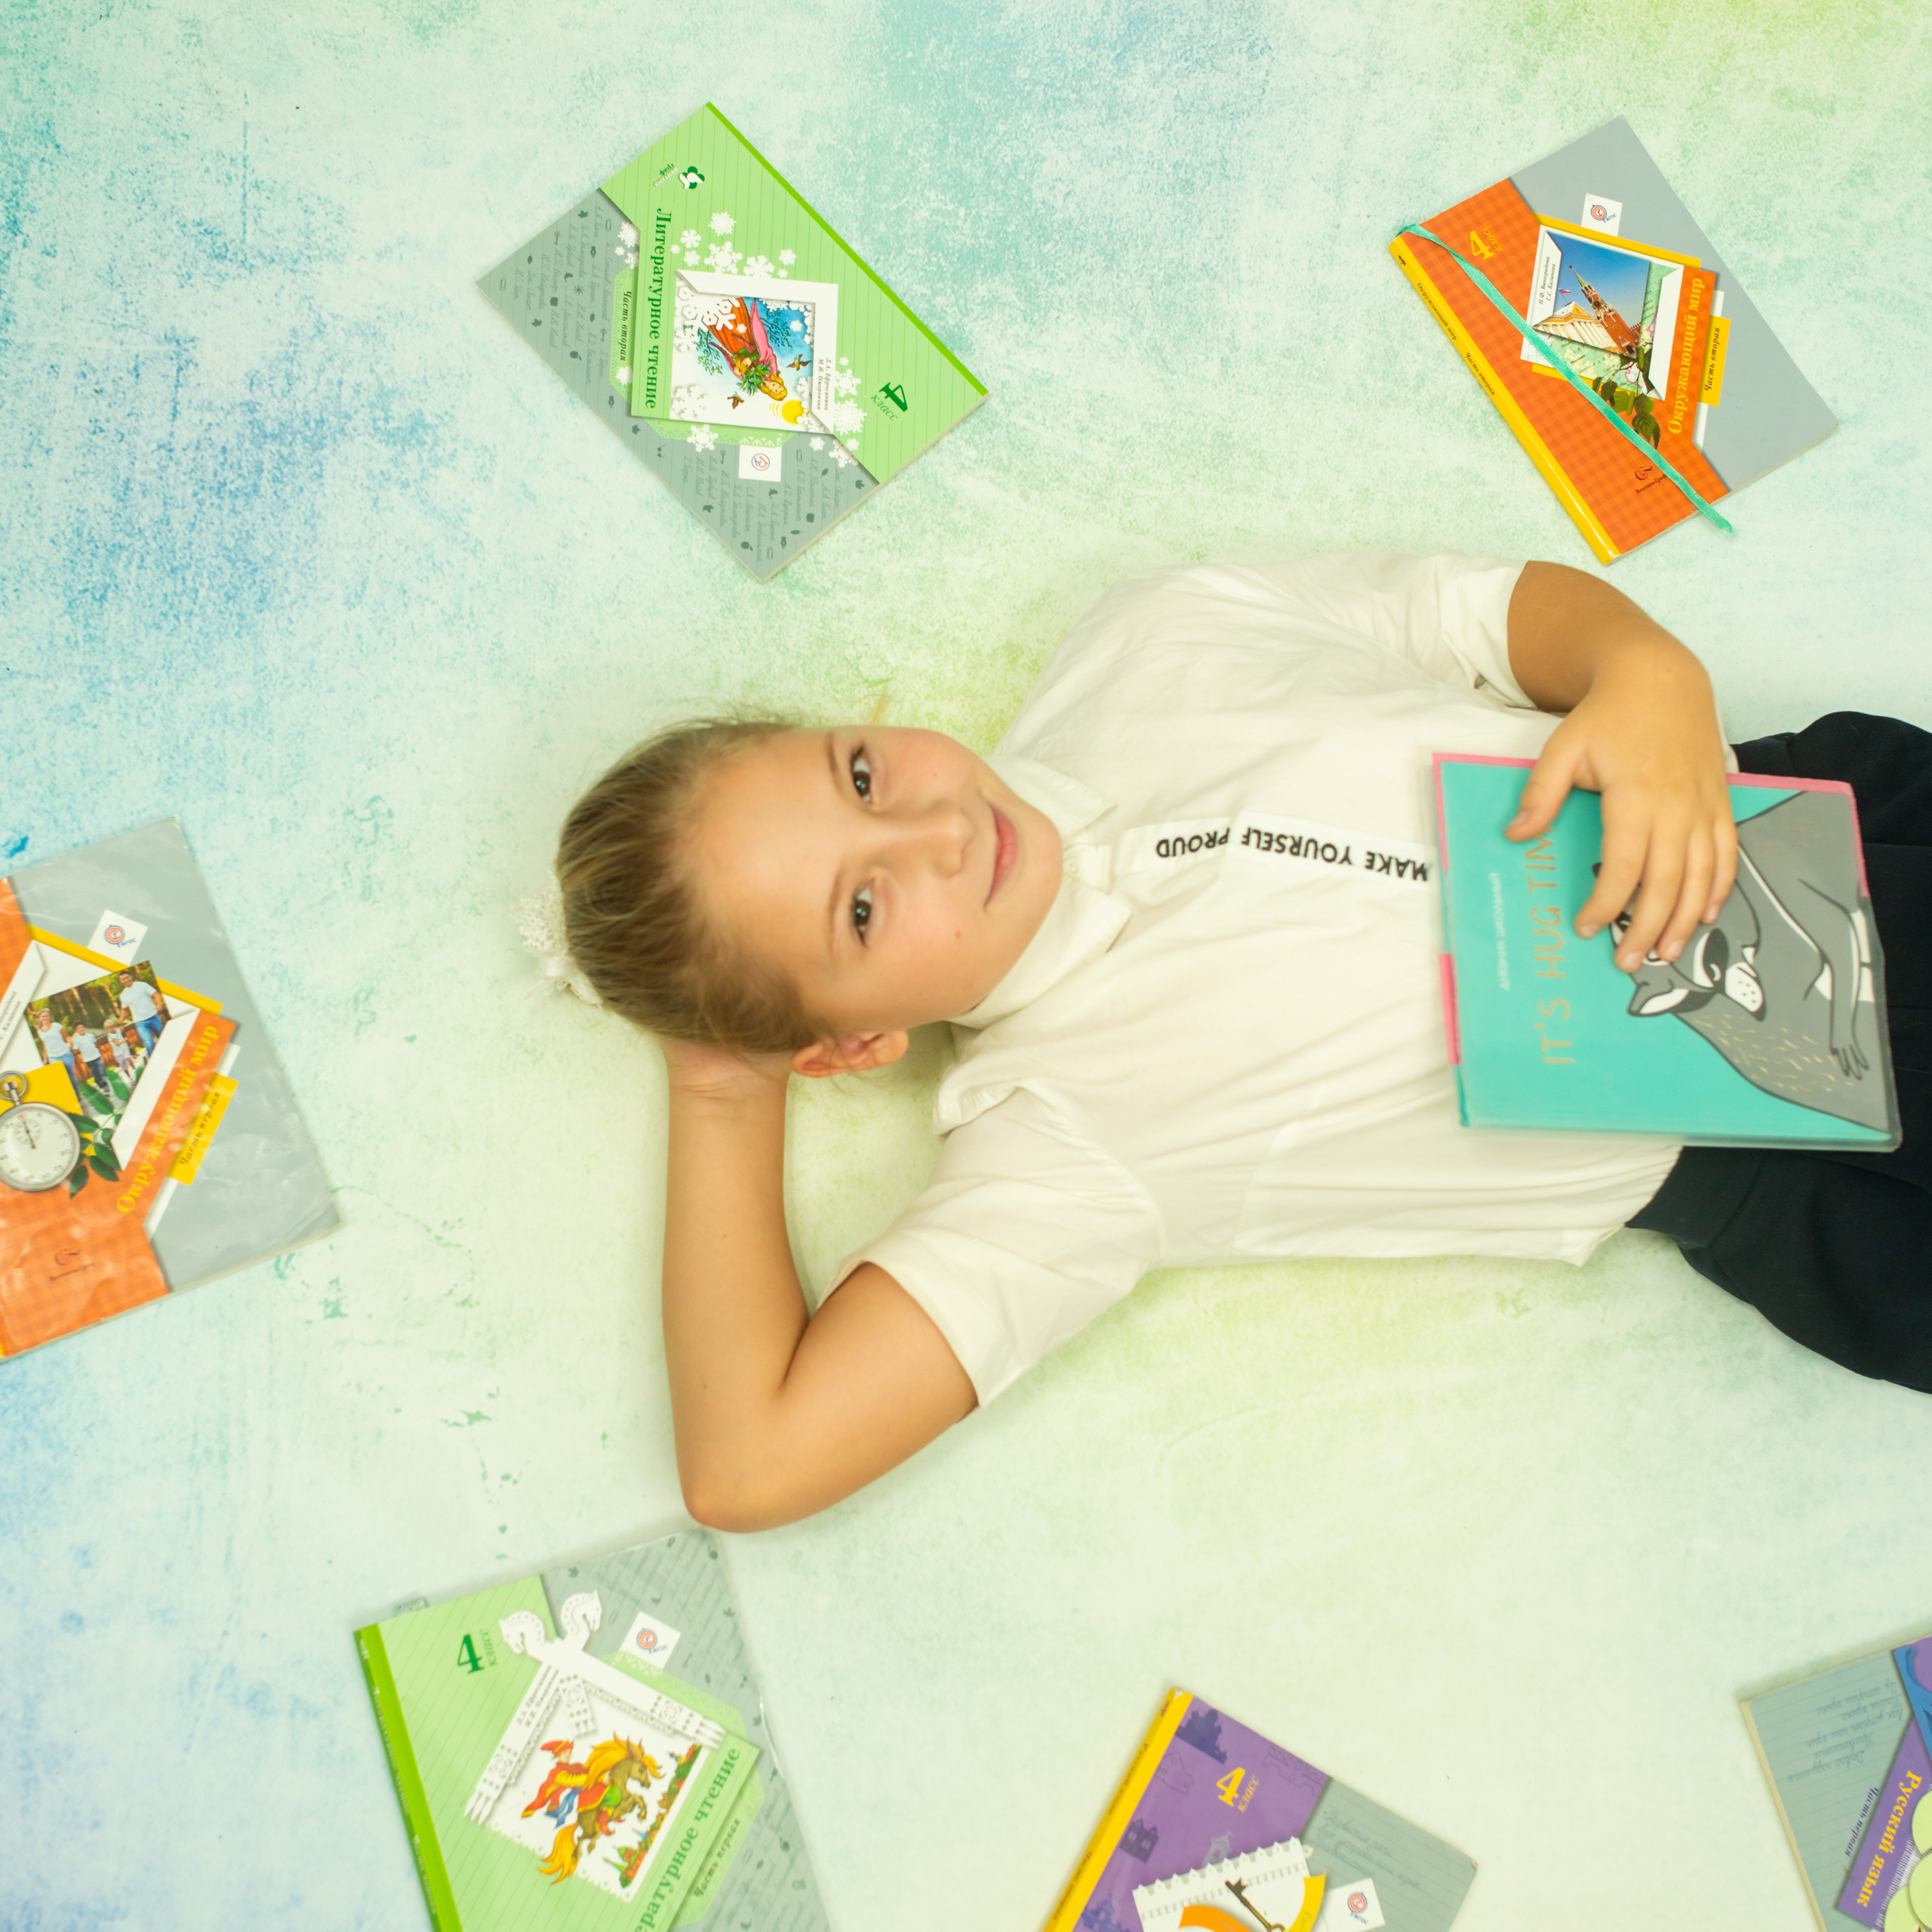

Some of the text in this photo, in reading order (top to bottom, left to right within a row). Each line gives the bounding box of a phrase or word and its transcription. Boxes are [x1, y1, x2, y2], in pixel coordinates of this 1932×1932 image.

[1395, 254, 1407, 266] 4
[1469, 229, 1496, 261] 4
[1480, 225, 1503, 252] класс
[618, 291, 632, 361] Часть вторая
[645, 208, 671, 408] Литературное чтение
[1415, 281, 1458, 341] Окружающий мир
[1463, 352, 1496, 396] Часть вторая
[1667, 277, 1703, 434] Окружающий мир
[1703, 327, 1722, 391] Часть вторая
[871, 395, 898, 422] класс
[878, 382, 908, 412] 4
[1156, 826, 1429, 881] MAKE YOURSELF PROUD
[1524, 826, 1574, 1064] IT'S HUG TIM
[116, 1025, 219, 1214] Окружающий мир
[178, 1091, 222, 1167] Часть первая
[457, 1633, 485, 1674] 4
[1217, 1767, 1246, 1807] 4
[1237, 1774, 1260, 1813] класс
[632, 1826, 700, 1932] ературное
[694, 1748, 740, 1823] чтение
[1844, 1787, 1879, 1857] Часть первая
[1857, 1770, 1923, 1908] Русский язык
[692, 1817, 743, 1899] Часть первая
